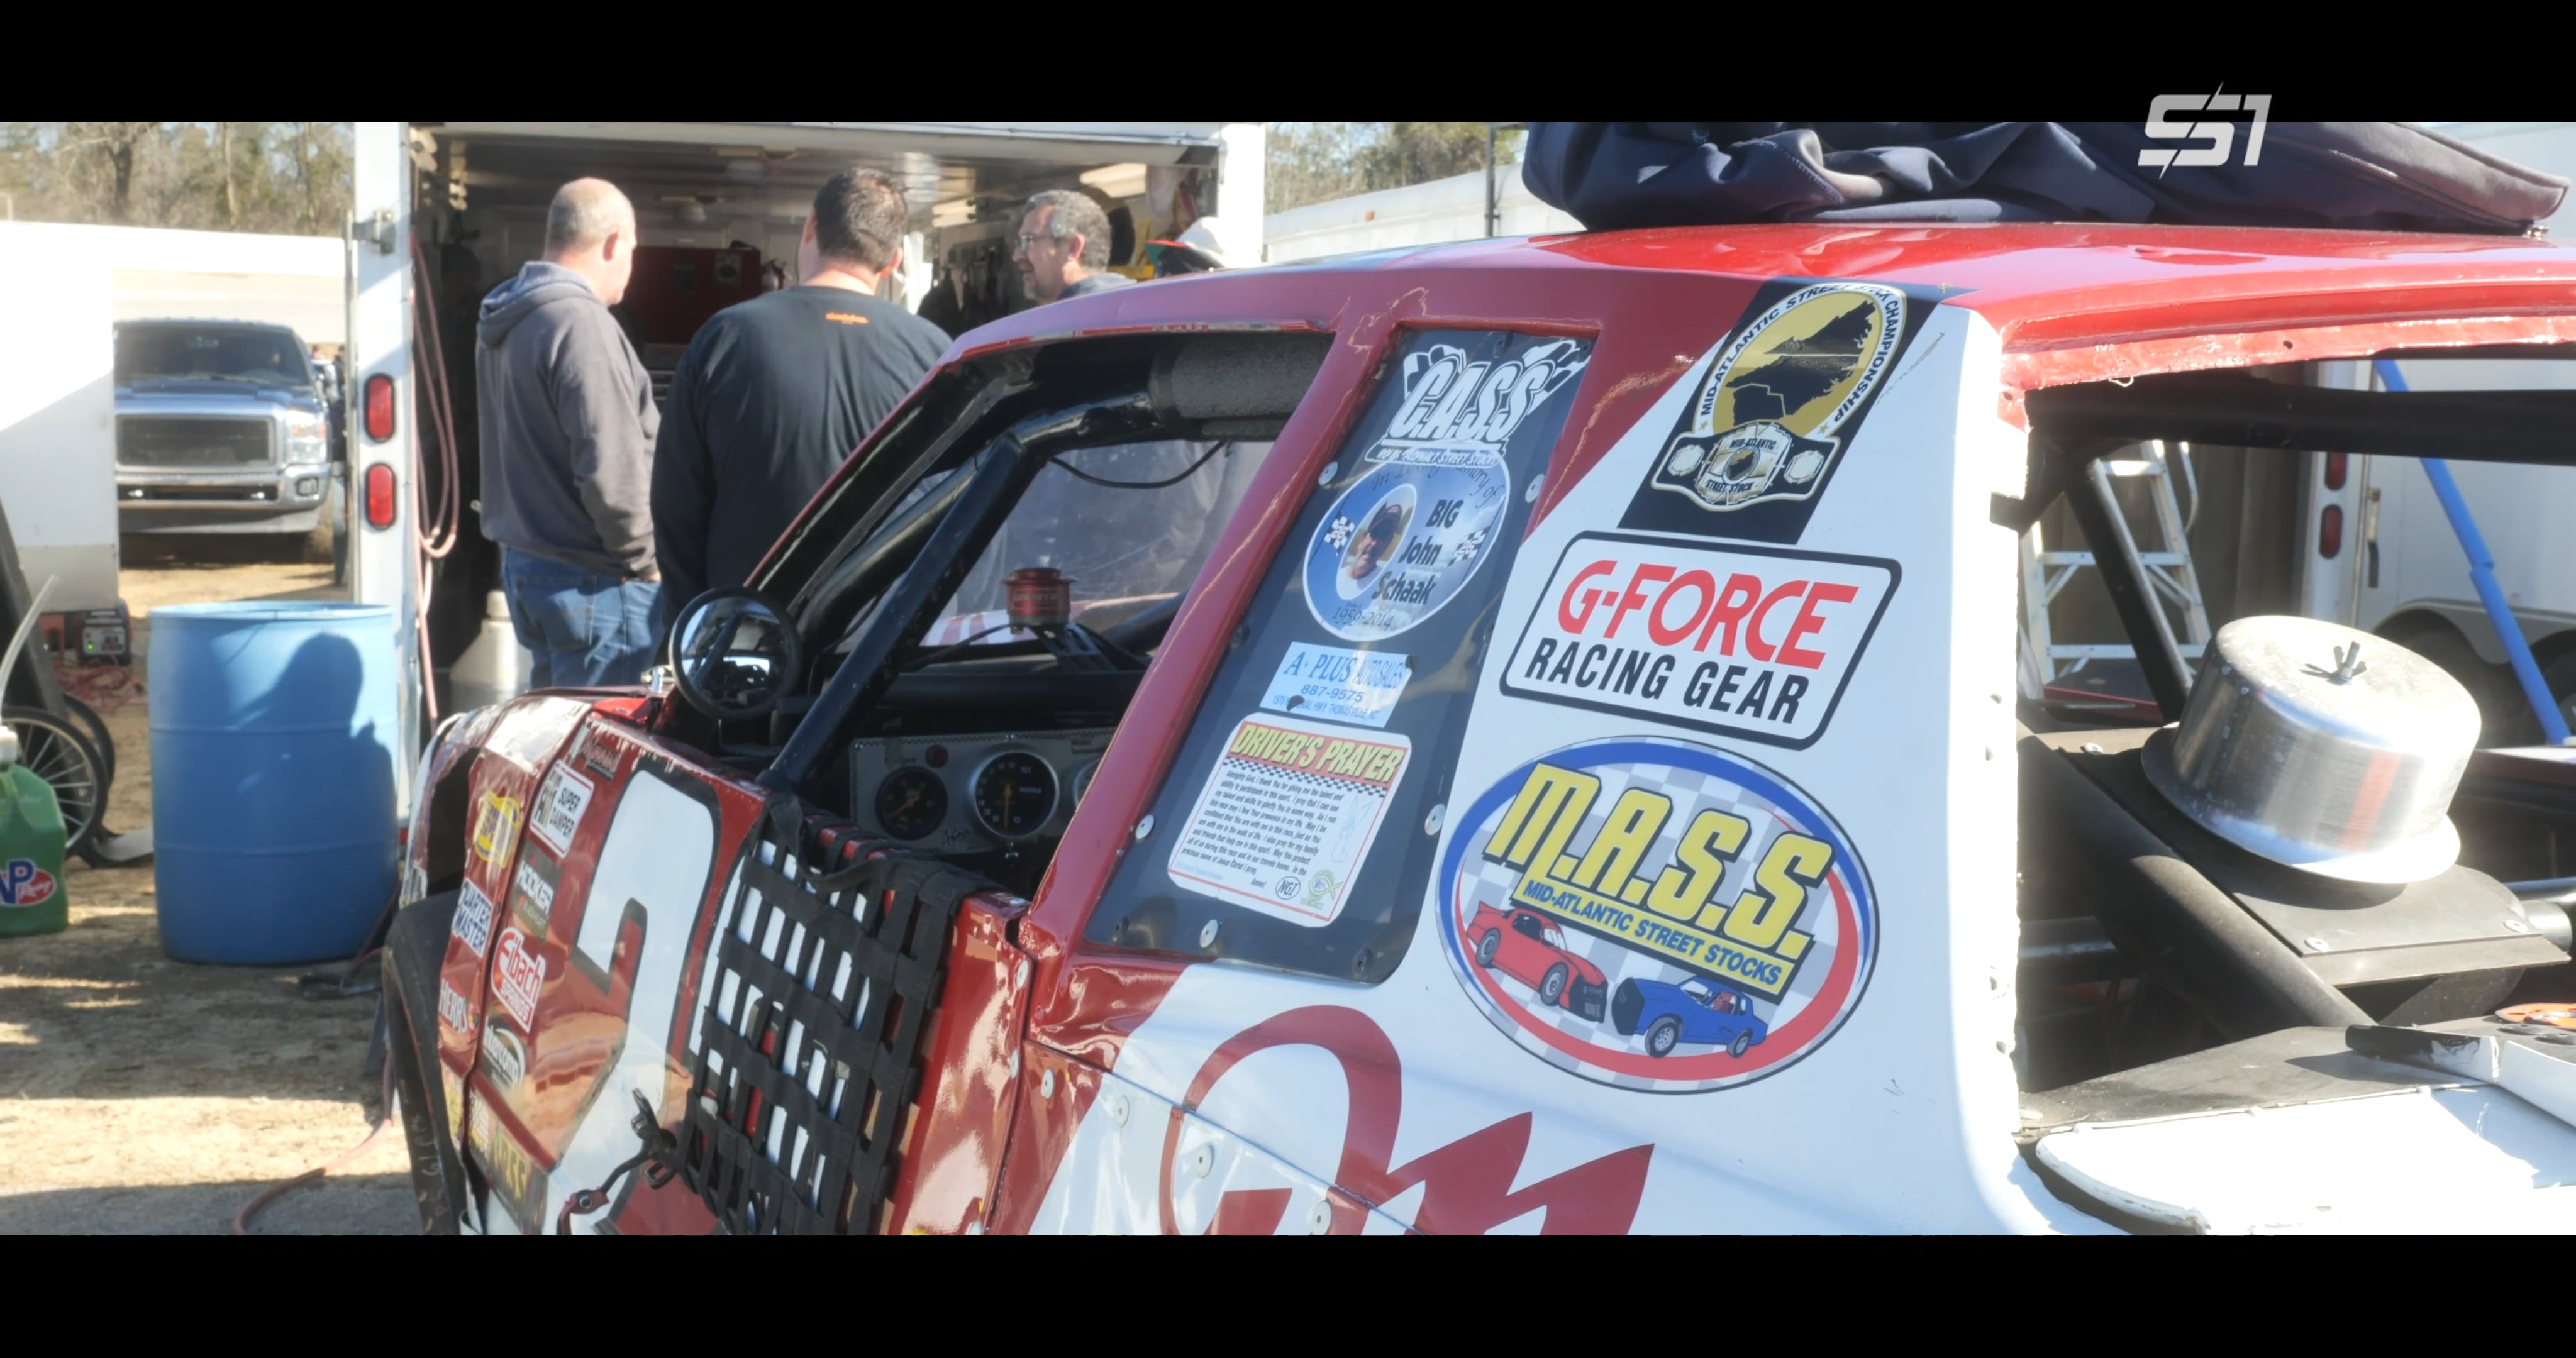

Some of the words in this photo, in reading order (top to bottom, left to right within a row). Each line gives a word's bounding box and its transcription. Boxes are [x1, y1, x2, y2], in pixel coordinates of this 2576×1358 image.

[1786, 284, 1846, 309] STREET
[1855, 284, 1892, 302] STOCK
[1700, 308, 1782, 416] MID-ATLANTIC
[1834, 299, 1900, 422] CHAMPIONSHIP
[1729, 438, 1777, 450] MID-ATLANTIC
[1706, 480, 1727, 492] STREET
[1729, 482, 1756, 493] STOCK
[1425, 499, 1464, 529] BIG
[1397, 536, 1443, 566] John
[1371, 571, 1436, 605] Schaak
[1332, 605, 1396, 629] 1959-2014
[1558, 560, 1859, 670] G-FORCE
[1301, 684, 1365, 703] 887-9575
[1524, 637, 1676, 700] RACING
[1683, 661, 1809, 724] GEAR
[1231, 724, 1324, 768] DRIVER'S
[1316, 739, 1406, 783] PRAYER
[558, 787, 580, 815] SUPER
[549, 807, 574, 839] DAMPER
[1483, 763, 1835, 961] M.A.S.S.
[517, 861, 554, 915] HOOKER
[1277, 881, 1297, 895] NGI
[452, 908, 488, 956] MASTER
[1523, 880, 1633, 931] MID-ATLANTIC
[1634, 920, 1705, 956] STREET
[1704, 944, 1782, 986] STOCKS
[501, 978, 530, 1021] SPRINGS
